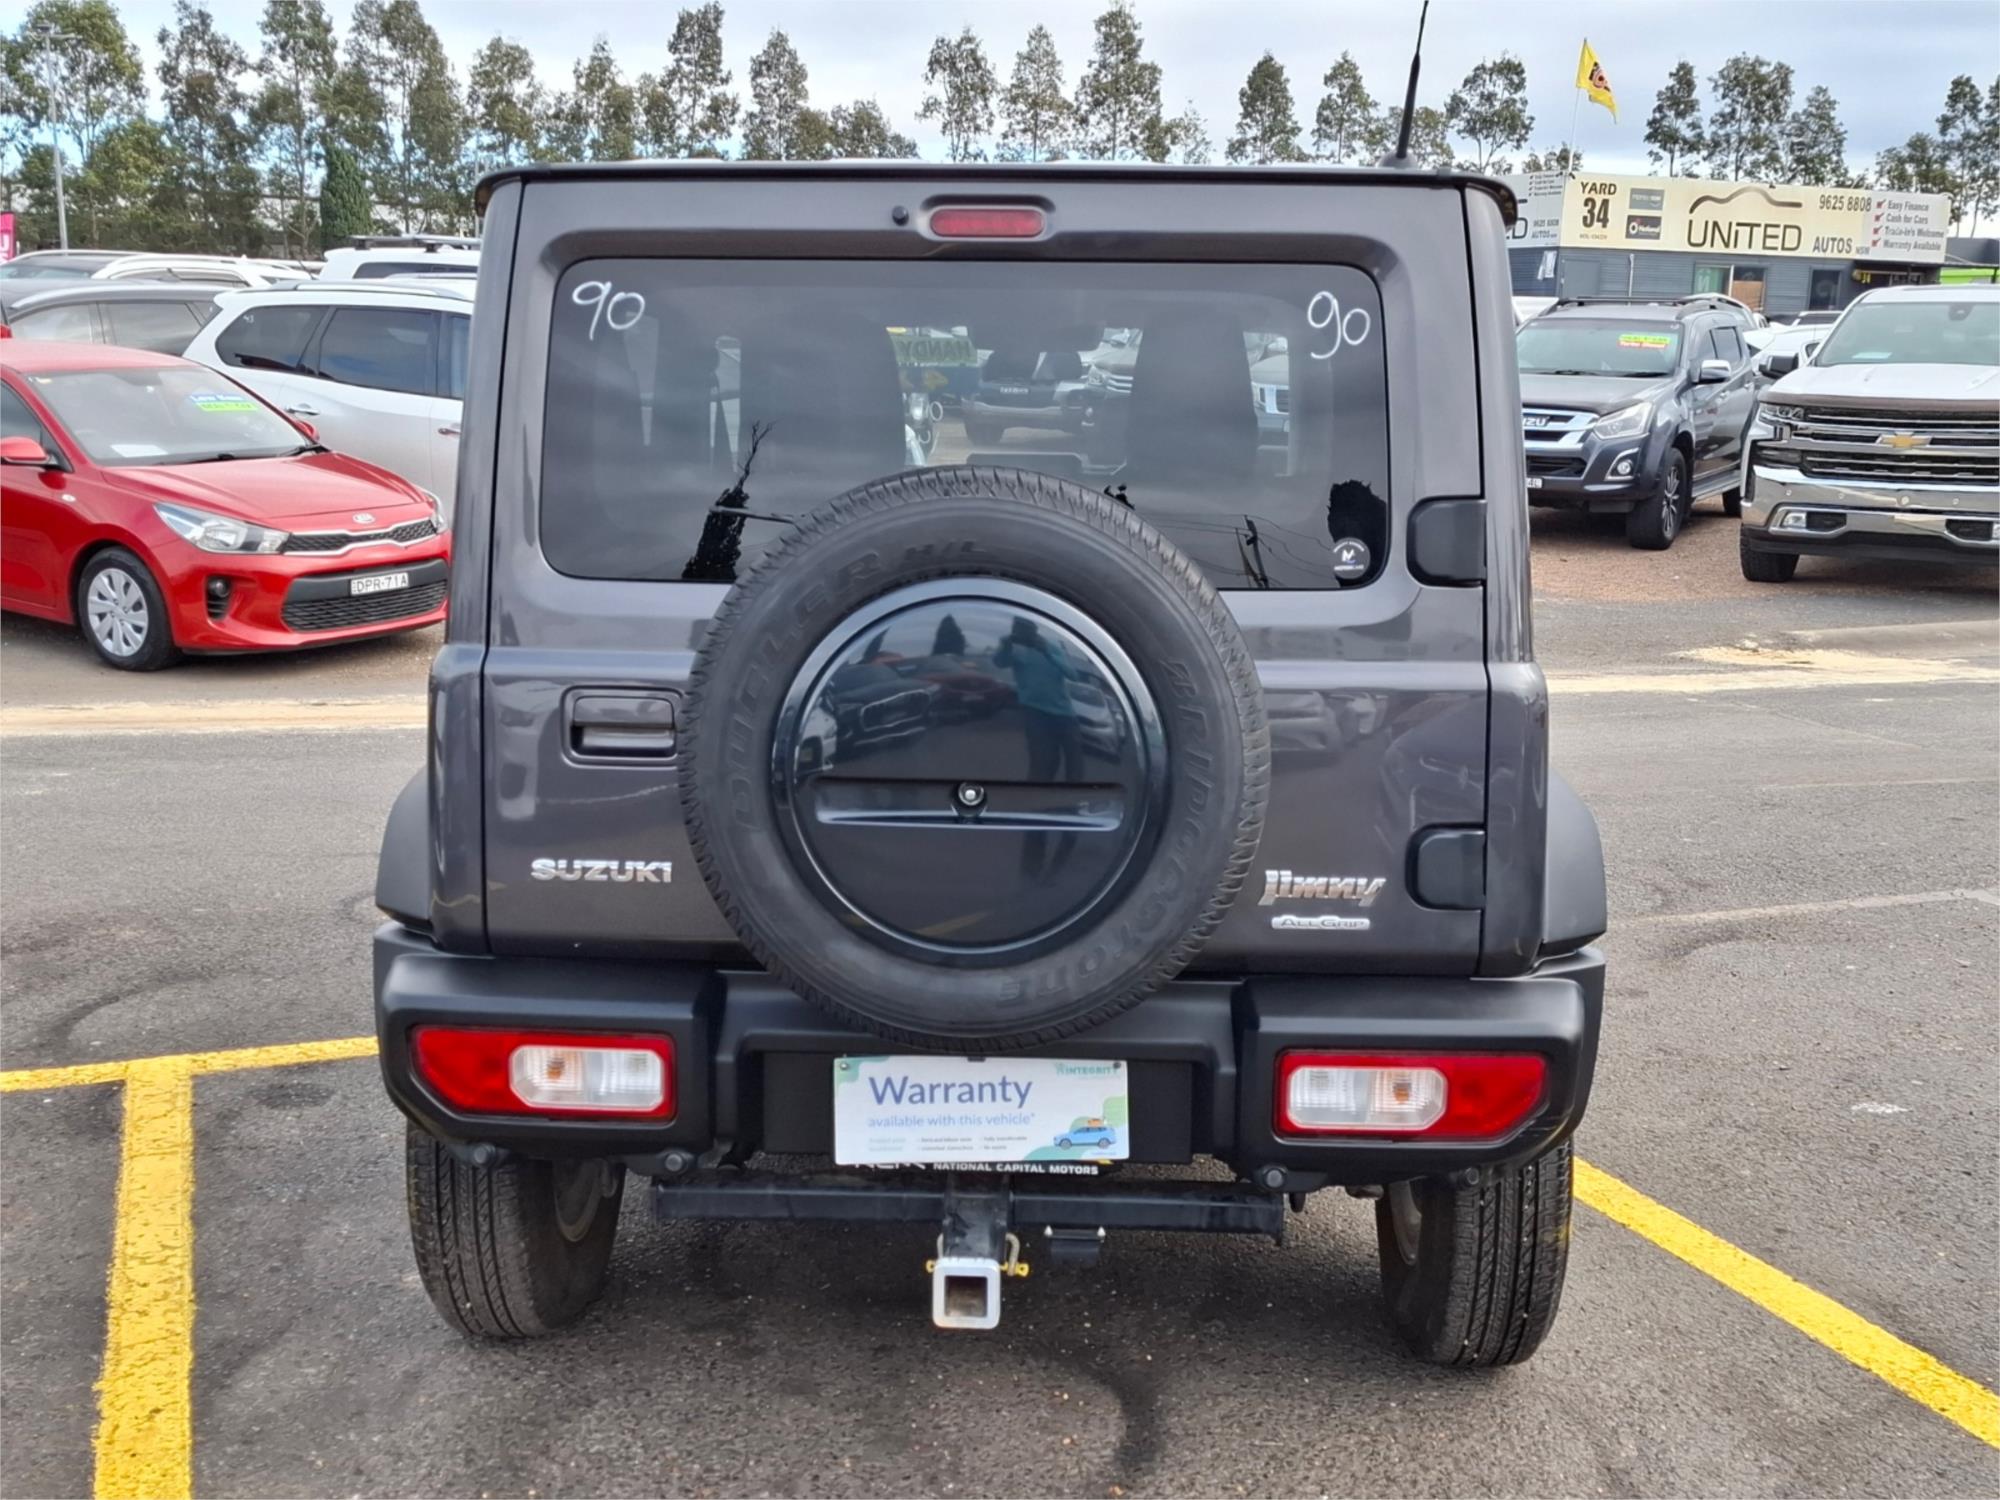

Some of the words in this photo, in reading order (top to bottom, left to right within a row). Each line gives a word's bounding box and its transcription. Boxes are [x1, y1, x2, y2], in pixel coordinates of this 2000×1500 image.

[1580, 182, 1618, 196] YARD
[1582, 197, 1610, 229] 34
[1818, 193, 1845, 211] 9625
[1847, 195, 1873, 213] 8808
[1887, 200, 1903, 212] Easy
[1886, 213, 1902, 223] Cash
[1914, 215, 1928, 224] Cars
[1812, 236, 1854, 255] AUTOS
[572, 281, 646, 340] 90
[1307, 290, 1371, 359] 90
[531, 858, 673, 883] SUZUKI
[1258, 870, 1386, 907] Jimny
[868, 1075, 1033, 1109] Warranty
[867, 1115, 925, 1129] available
[927, 1114, 956, 1127] with
[958, 1113, 983, 1126] this
[932, 1162, 993, 1173] NATIONAL
[996, 1163, 1046, 1174] CAPITAL
[1049, 1165, 1100, 1176] MOTORS
